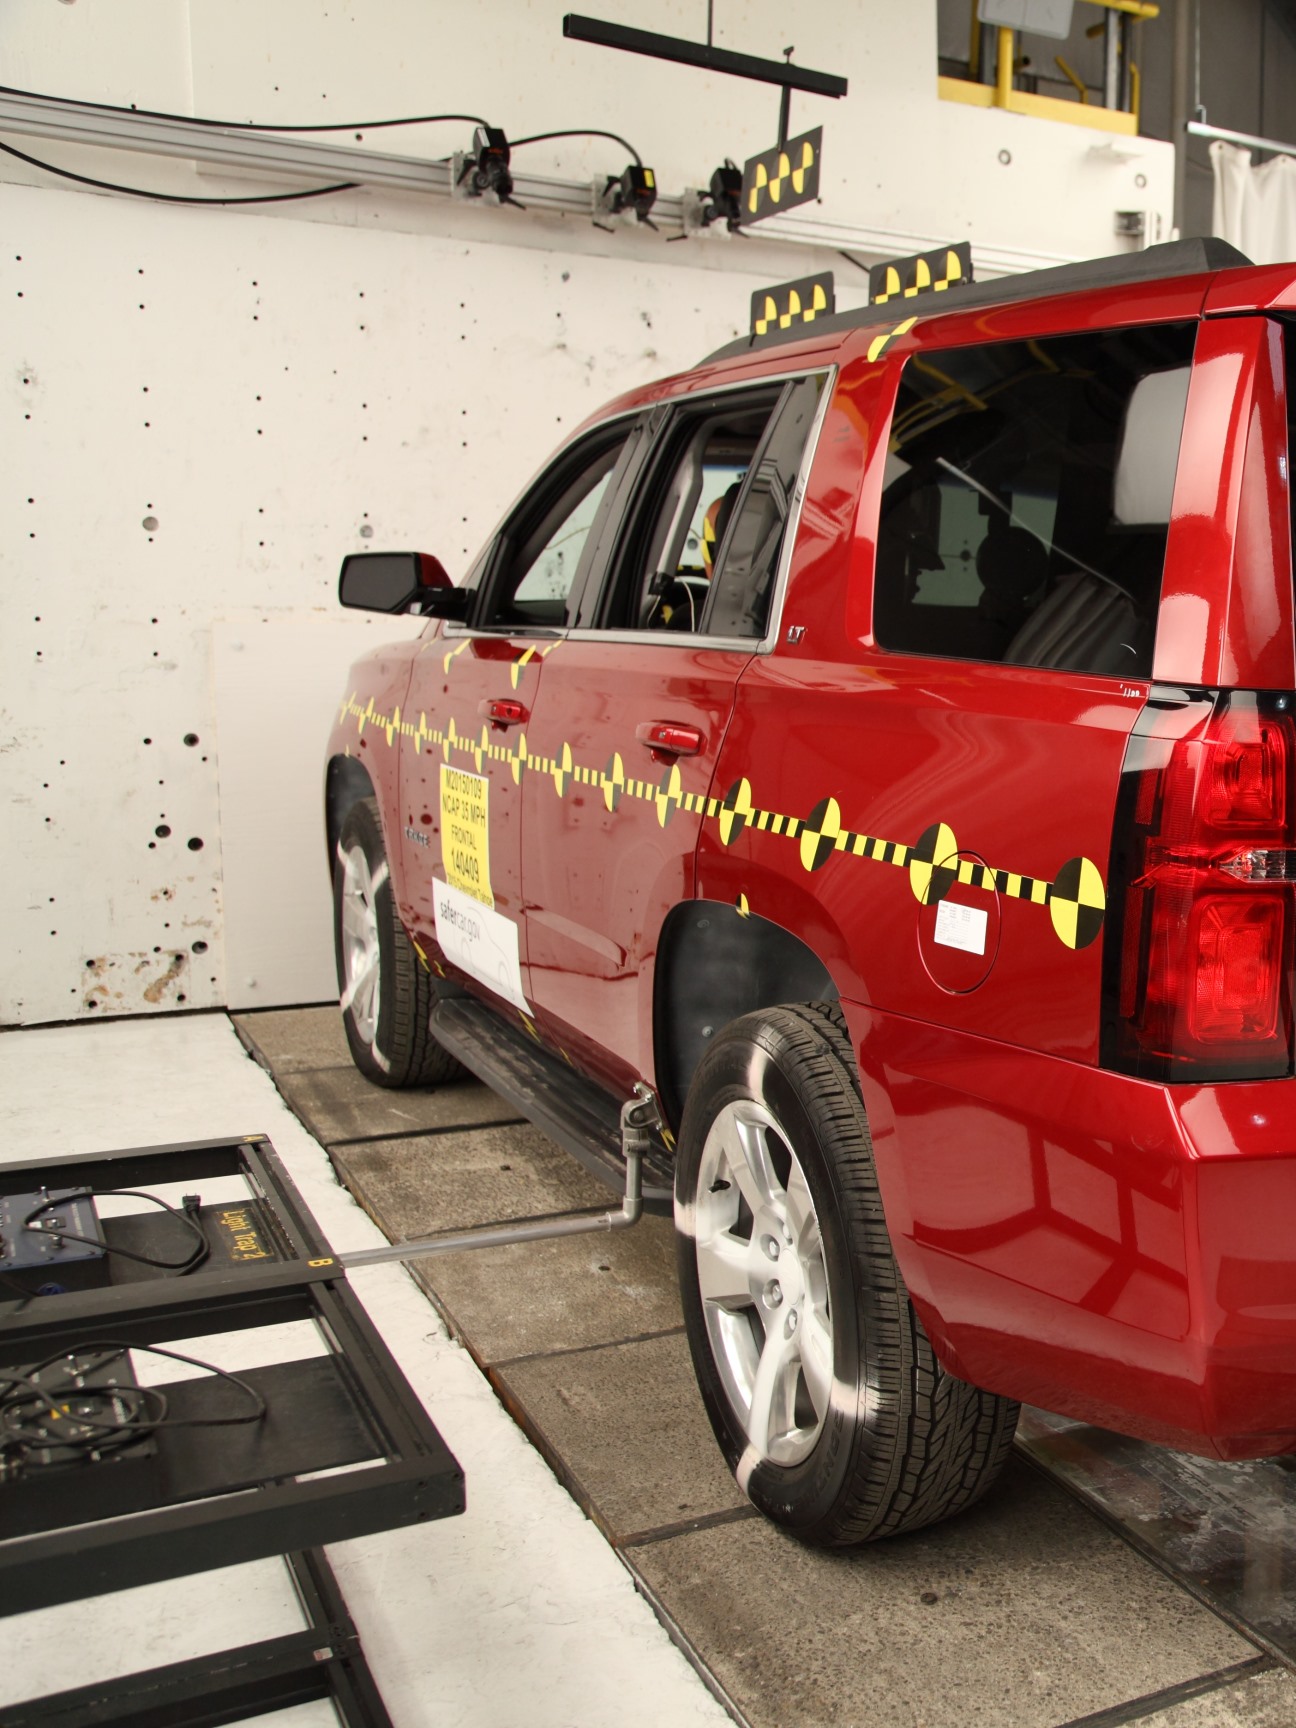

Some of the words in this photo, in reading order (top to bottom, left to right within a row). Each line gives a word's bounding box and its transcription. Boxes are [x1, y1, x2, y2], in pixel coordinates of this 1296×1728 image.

[446, 769, 482, 800] M20150109
[443, 793, 460, 816] NCAP
[461, 800, 469, 821] 35
[470, 803, 486, 828] MPH
[451, 823, 477, 850] FRONTAL
[451, 847, 479, 884] 140409
[440, 899, 480, 943] safercar.gov
[221, 1209, 251, 1232] Light
[233, 1231, 257, 1251] Trap
[308, 1258, 334, 1267] B
